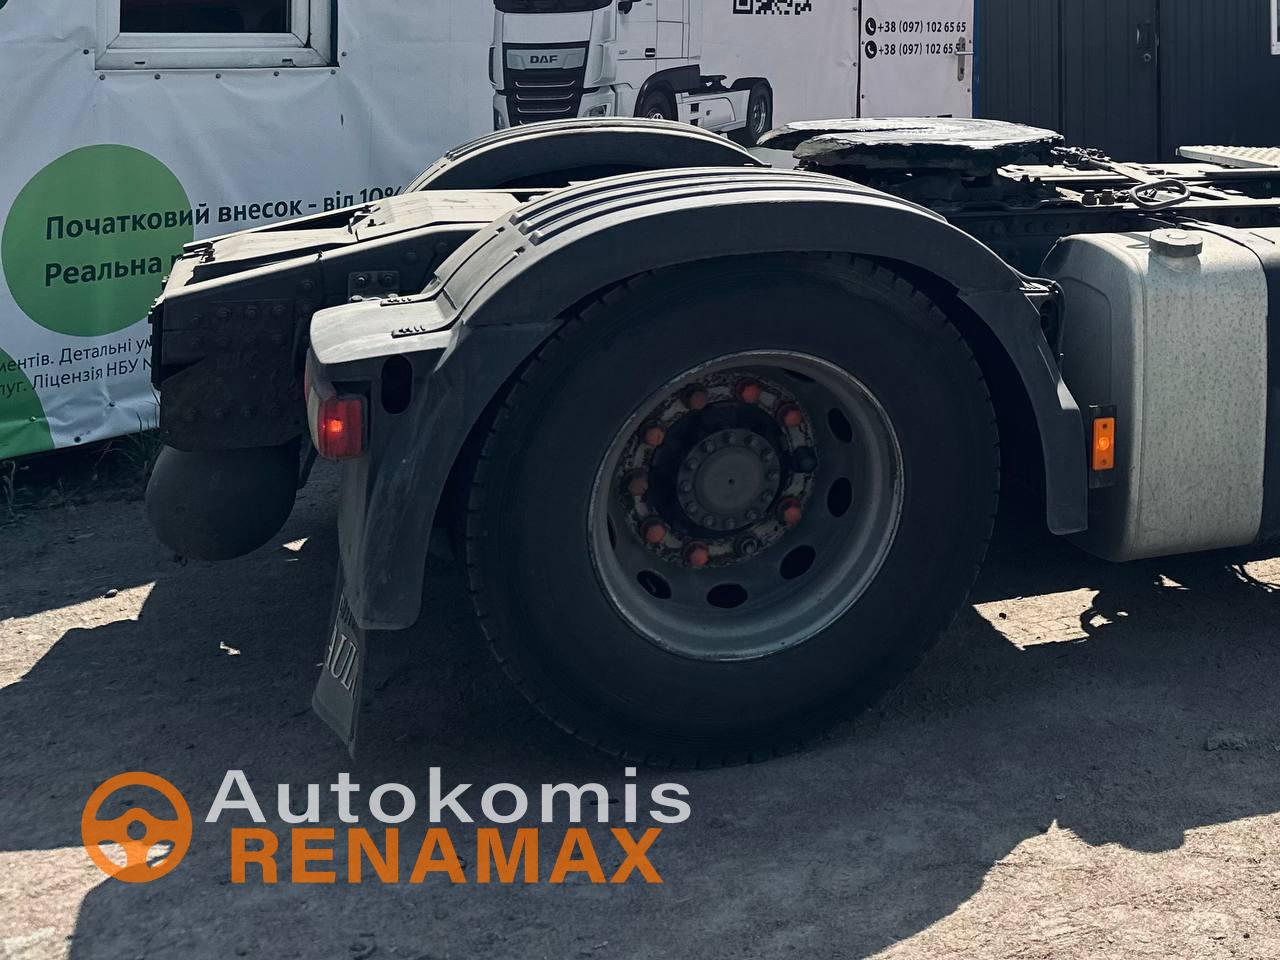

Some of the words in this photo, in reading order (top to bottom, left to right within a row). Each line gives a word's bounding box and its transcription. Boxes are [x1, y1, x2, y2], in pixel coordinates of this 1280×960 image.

[878, 21, 896, 33] +38
[899, 20, 923, 34] (097)
[926, 21, 942, 33] 102
[944, 21, 955, 33] 65
[956, 21, 967, 33] 65
[529, 55, 559, 64] DAF
[879, 44, 896, 56] +38
[899, 43, 923, 57] (097)
[926, 43, 941, 55] 102
[943, 43, 953, 54] 65
[46, 203, 210, 241] Початковий
[218, 198, 303, 224] внесок
[45, 255, 162, 287] Реальна
[59, 338, 131, 365] Детальні
[32, 366, 103, 390] Ліцензія
[107, 359, 138, 377] НБУ
